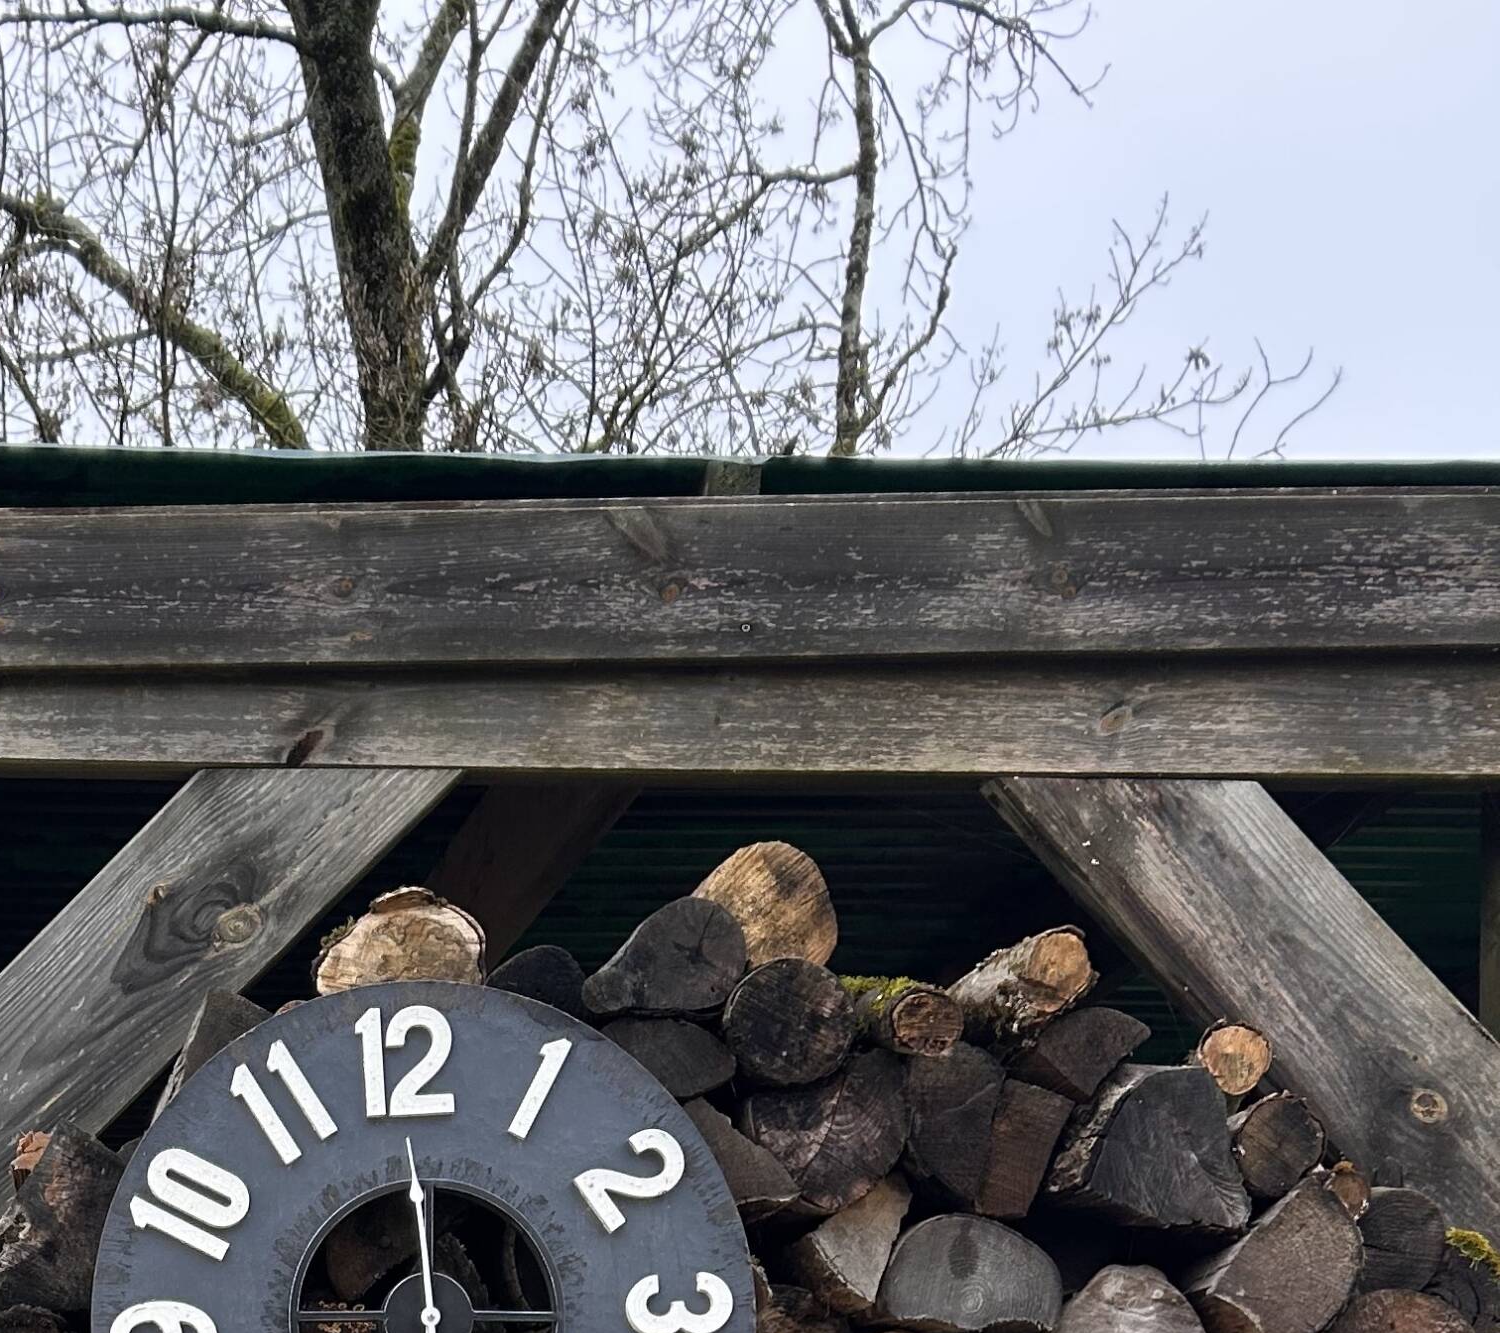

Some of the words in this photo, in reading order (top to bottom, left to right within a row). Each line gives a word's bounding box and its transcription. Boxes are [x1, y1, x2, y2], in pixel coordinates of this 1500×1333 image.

[230, 1039, 338, 1165] 11
[354, 1005, 455, 1117] 12
[507, 1038, 573, 1140] 1
[130, 1147, 250, 1262] 10
[573, 1128, 685, 1234] 2
